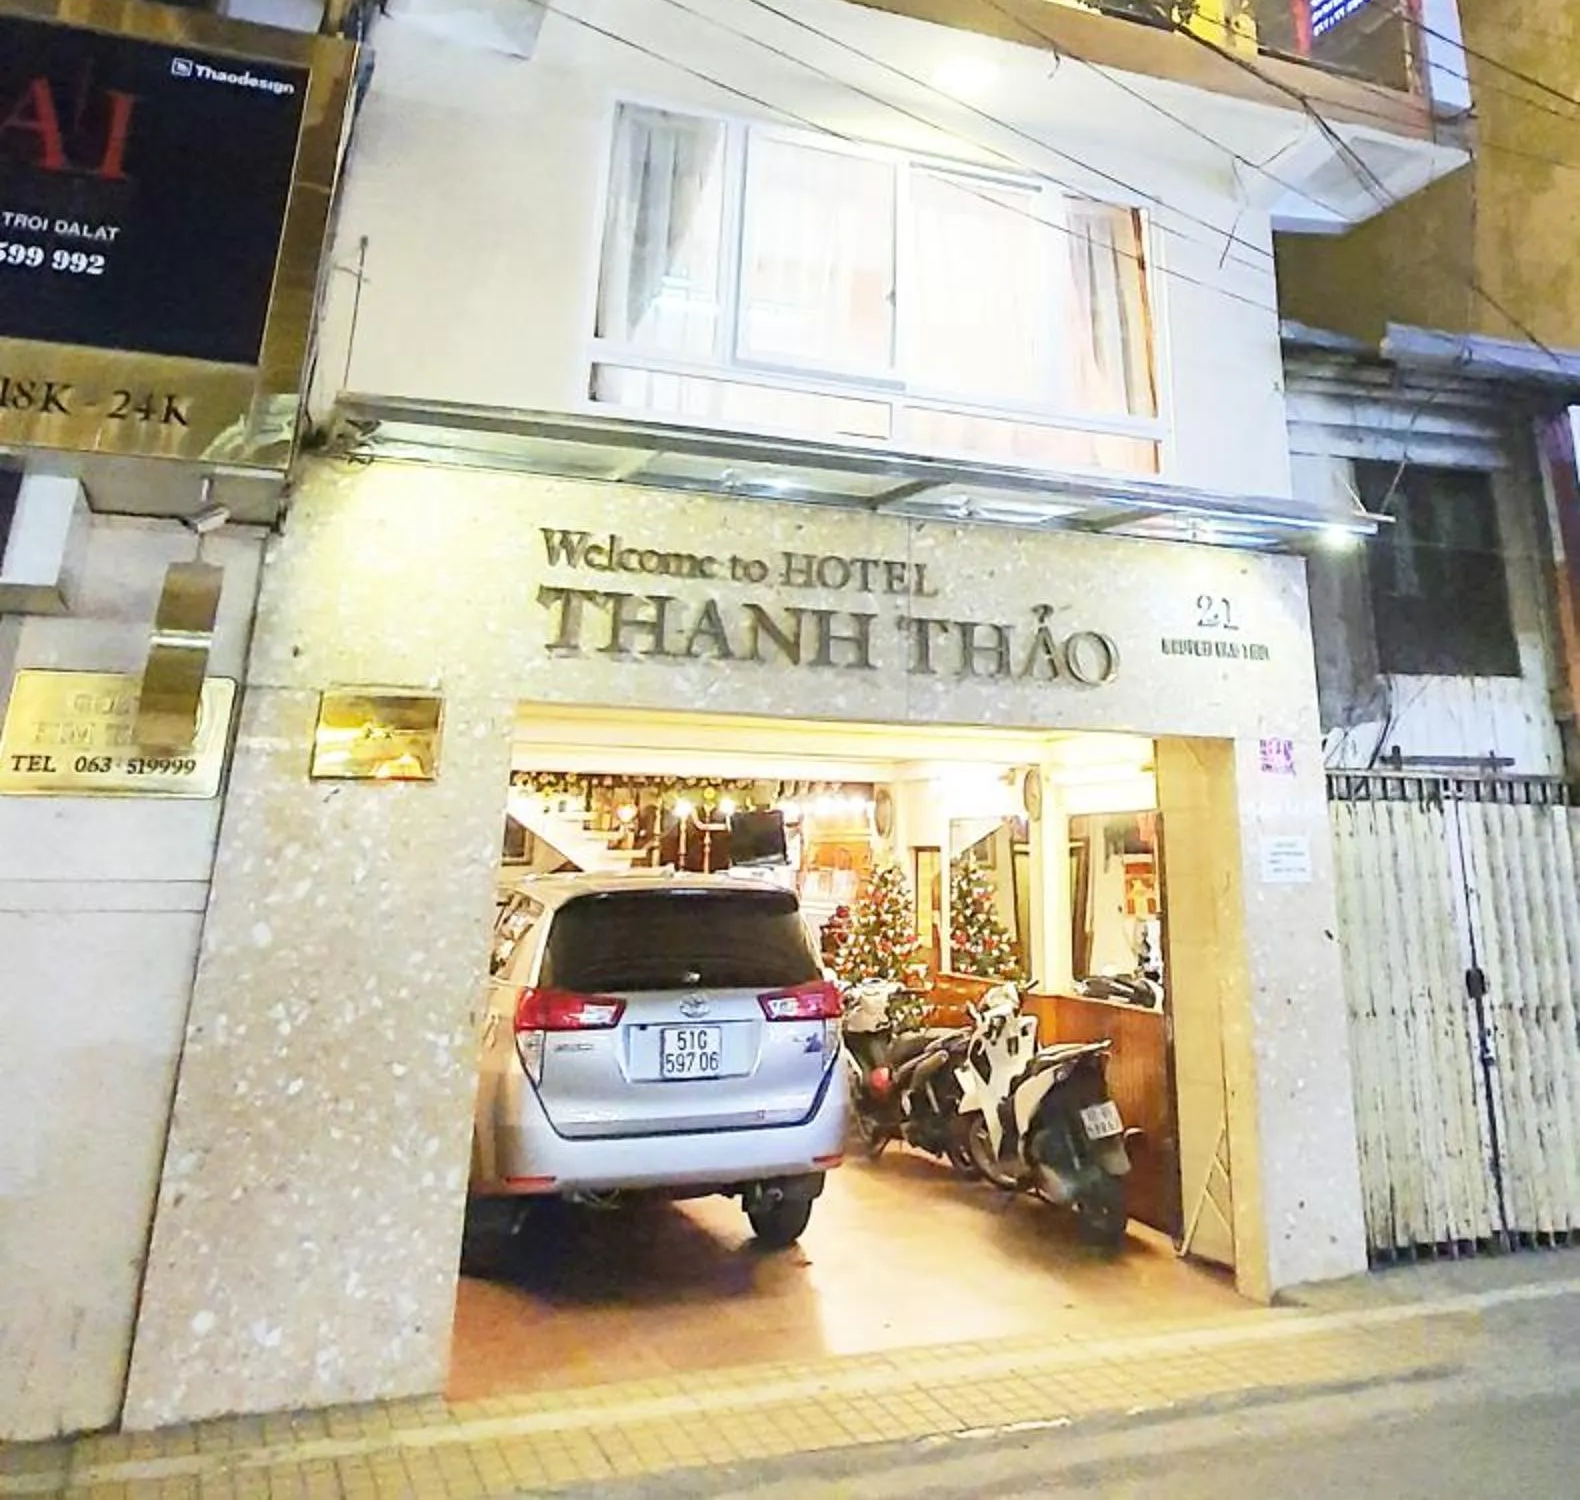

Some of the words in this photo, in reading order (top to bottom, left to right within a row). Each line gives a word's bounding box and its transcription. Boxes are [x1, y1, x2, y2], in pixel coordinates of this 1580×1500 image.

[194, 63, 295, 95] Thaodesign
[54, 219, 120, 241] DALAT
[52, 250, 105, 275] 992
[107, 390, 188, 426] 24K
[540, 527, 718, 578] Welcome
[730, 554, 769, 583] to
[779, 551, 940, 598] HOTEL
[1196, 594, 1240, 631] 21
[537, 584, 878, 670] THANH
[897, 603, 1120, 687] THẢO
[11, 754, 57, 774] TEL
